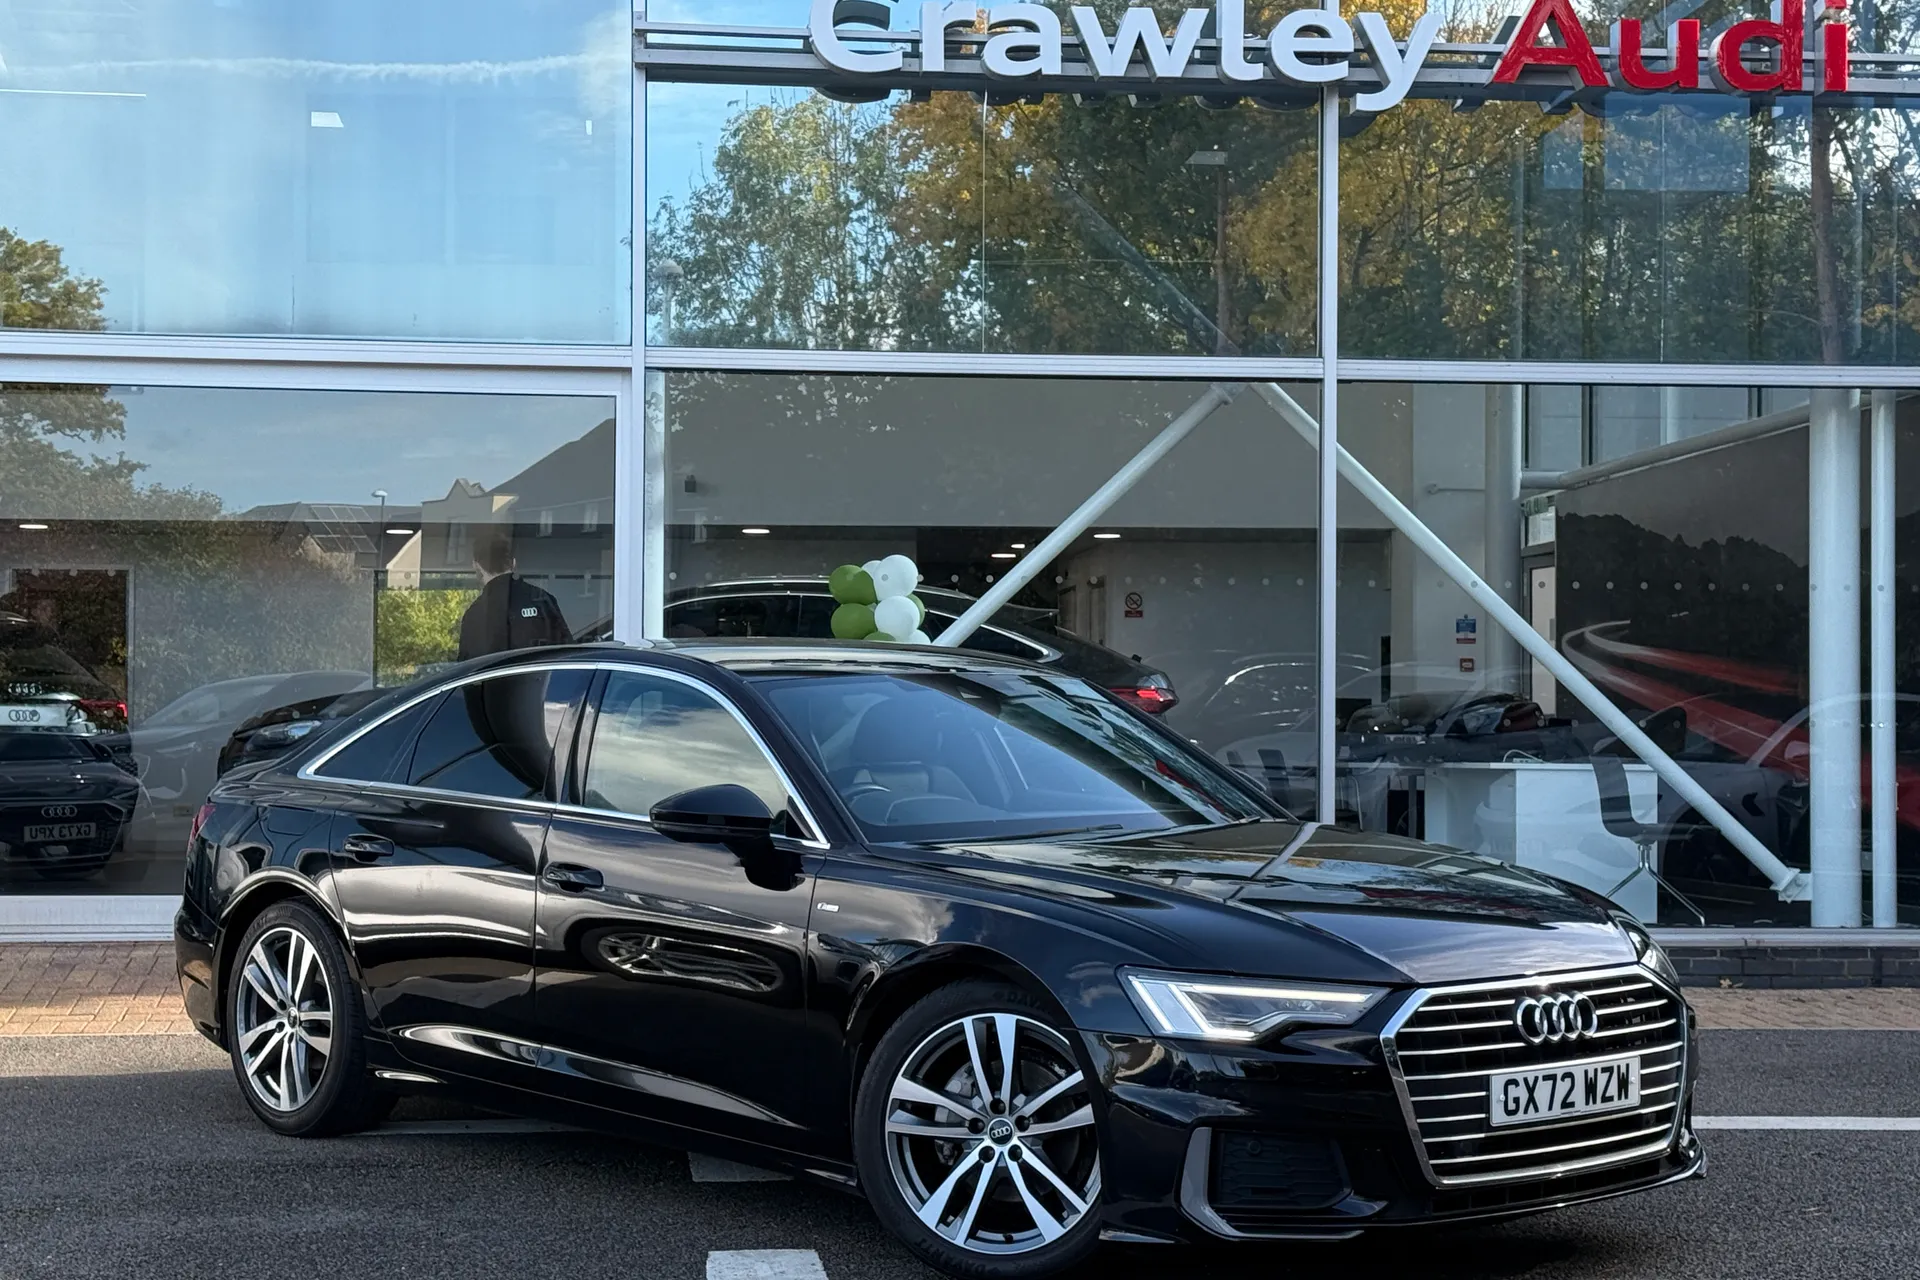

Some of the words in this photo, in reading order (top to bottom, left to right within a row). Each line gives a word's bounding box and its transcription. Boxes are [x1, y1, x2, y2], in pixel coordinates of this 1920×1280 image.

[808, 0, 1444, 112] Crawley
[1491, 0, 1847, 92] Audi
[1503, 1071, 1576, 1117] GX72
[1584, 1063, 1630, 1106] WZW
